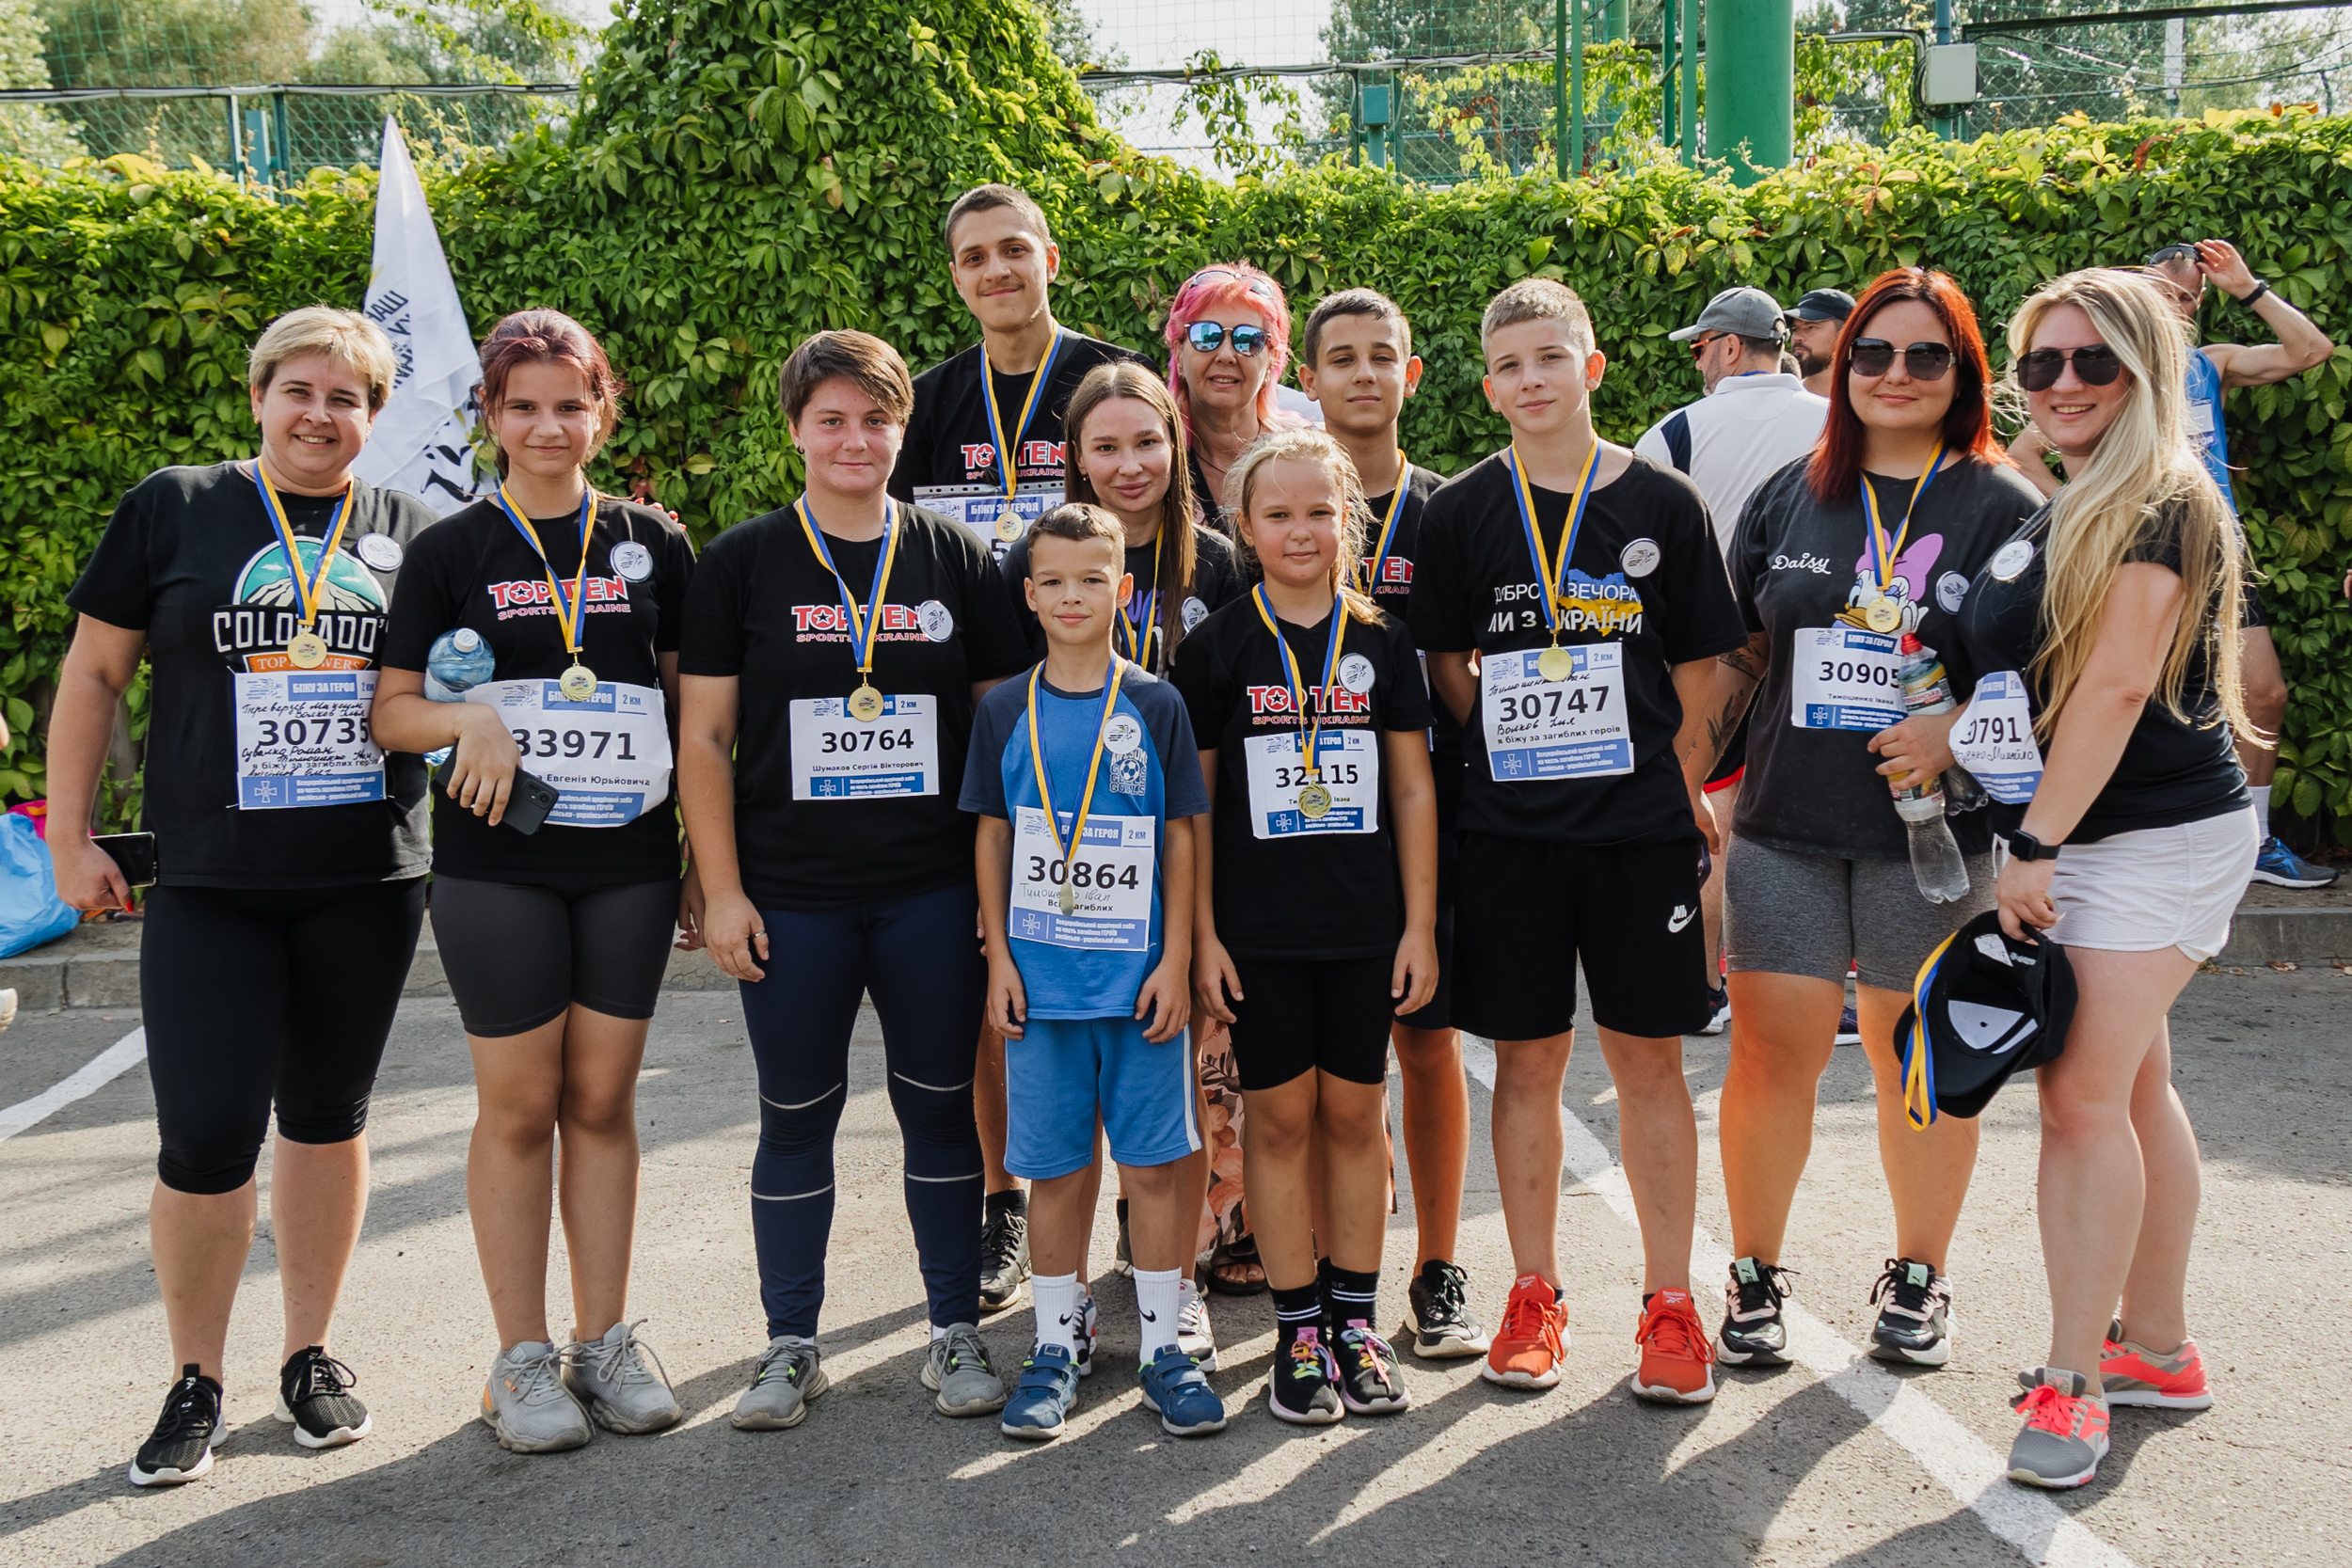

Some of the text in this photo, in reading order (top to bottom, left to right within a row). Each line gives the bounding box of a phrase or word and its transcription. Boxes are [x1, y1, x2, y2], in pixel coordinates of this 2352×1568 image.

[971, 504, 995, 515] БІЖУ
[1009, 501, 1039, 513] ГЕРОЯ
[1772, 552, 1832, 575] Daisy
[487, 576, 628, 609] TOP TEN
[498, 606, 558, 621] SPORTS
[791, 605, 849, 631] TOP
[1546, 606, 1643, 634] КРАЇНИ
[214, 611, 388, 654] COLOADO'
[796, 632, 930, 642] SPORTS KRAINE
[257, 657, 360, 671] TOP WERS
[1594, 653, 1598, 662] 2
[1819, 661, 1900, 689] 30905
[317, 683, 328, 692] ЗА
[623, 694, 628, 705] 2
[901, 700, 905, 708] 2
[1247, 686, 1371, 713] TOP TEN
[1500, 686, 1610, 722] 30747
[1252, 715, 1308, 725] SPORTS
[258, 718, 369, 746] 30735
[1505, 736, 1526, 744] біжу
[1543, 729, 1587, 740] загиблих
[1590, 725, 1620, 736] героїв
[512, 729, 636, 760] 33971
[821, 728, 914, 753] 30764
[262, 761, 286, 770] біжу
[306, 760, 352, 768] загиблих
[547, 774, 587, 784] Евгенія
[591, 776, 650, 786] Юрьйовича
[1276, 765, 1358, 788] 32115
[1083, 827, 1093, 837] ЗА
[1094, 828, 1119, 839] ГЕРОЯ
[1128, 830, 1134, 839] 2
[1027, 856, 1138, 890] 30864
[1020, 883, 1079, 898] Тимошео
[1073, 903, 1113, 911] агиблих
